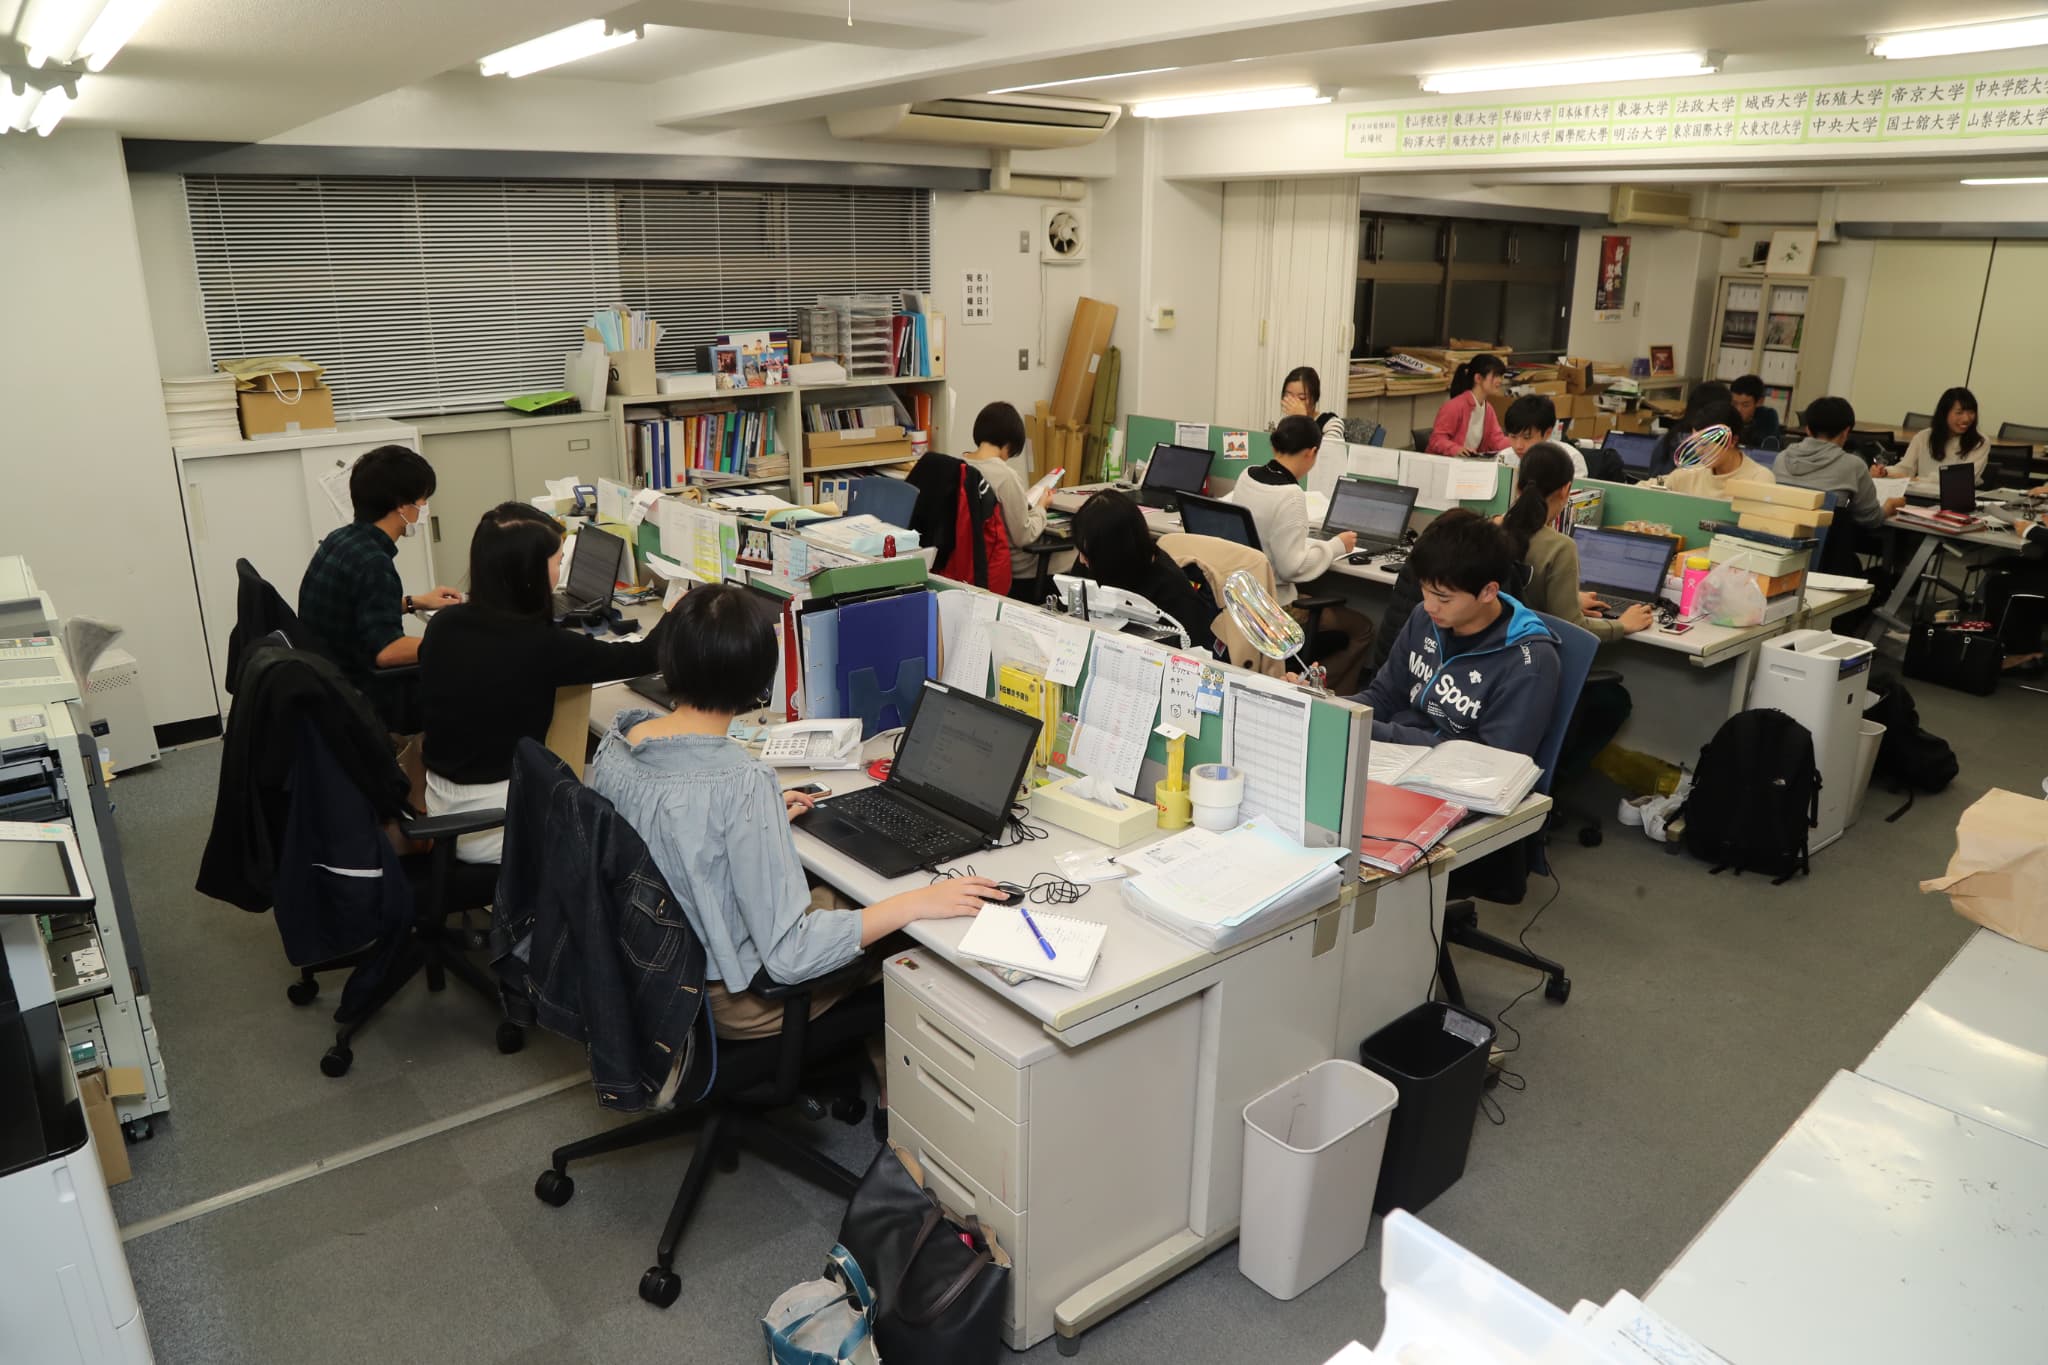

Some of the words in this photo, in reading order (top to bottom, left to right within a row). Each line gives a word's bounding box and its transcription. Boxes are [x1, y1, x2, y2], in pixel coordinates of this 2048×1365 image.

[1403, 134, 1447, 148] 駒澤大学
[1453, 133, 1495, 147] 順天堂大学
[1502, 130, 1551, 145] 神奈川大学
[1555, 127, 1608, 143] 國學院大學
[1613, 125, 1668, 142] 明治大学
[1673, 121, 1734, 139] 東京国際大学
[1739, 118, 1802, 136] 大東文化大学
[1813, 117, 1878, 134] 中央大学
[1967, 107, 2048, 128] 山梨学院大学
[1405, 113, 1448, 128] 青山学院大学
[1454, 111, 1498, 127] 東洋大学
[1503, 107, 1552, 123] 早稲田大学
[1558, 103, 1608, 119] 日本体育大学
[1618, 100, 1669, 117] 東海大学
[1676, 96, 1736, 113] 法政大学
[1744, 91, 1809, 109] 城西大学
[1816, 88, 1883, 107] 拓殖大学
[1892, 83, 1965, 104] 帝京大学
[1434, 673, 1482, 719] Sport
